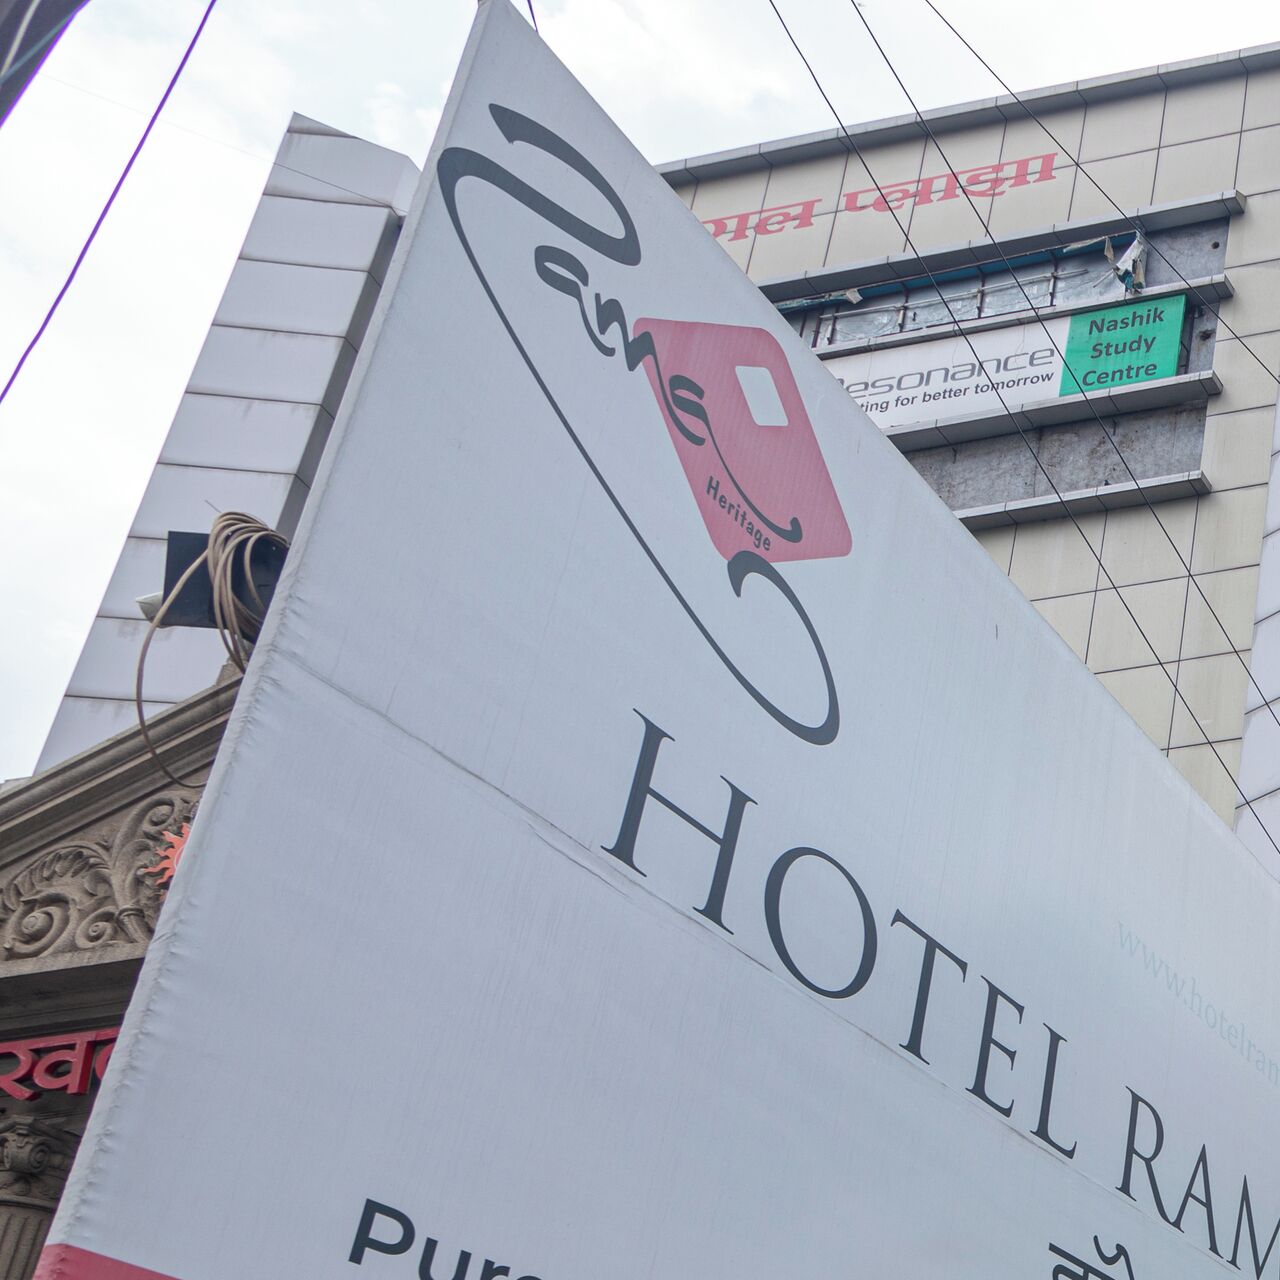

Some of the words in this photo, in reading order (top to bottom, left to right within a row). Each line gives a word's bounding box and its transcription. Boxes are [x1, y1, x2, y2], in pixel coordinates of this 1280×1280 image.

[1089, 307, 1165, 335] Nashik
[1091, 334, 1157, 359] Study
[838, 347, 1056, 398] esonance
[895, 395, 918, 408] for
[921, 386, 967, 403] better
[974, 371, 1055, 395] tomorrow
[1082, 361, 1157, 387] Centre
[706, 475, 771, 552] Heritage
[600, 708, 1078, 1160] HOTEL
